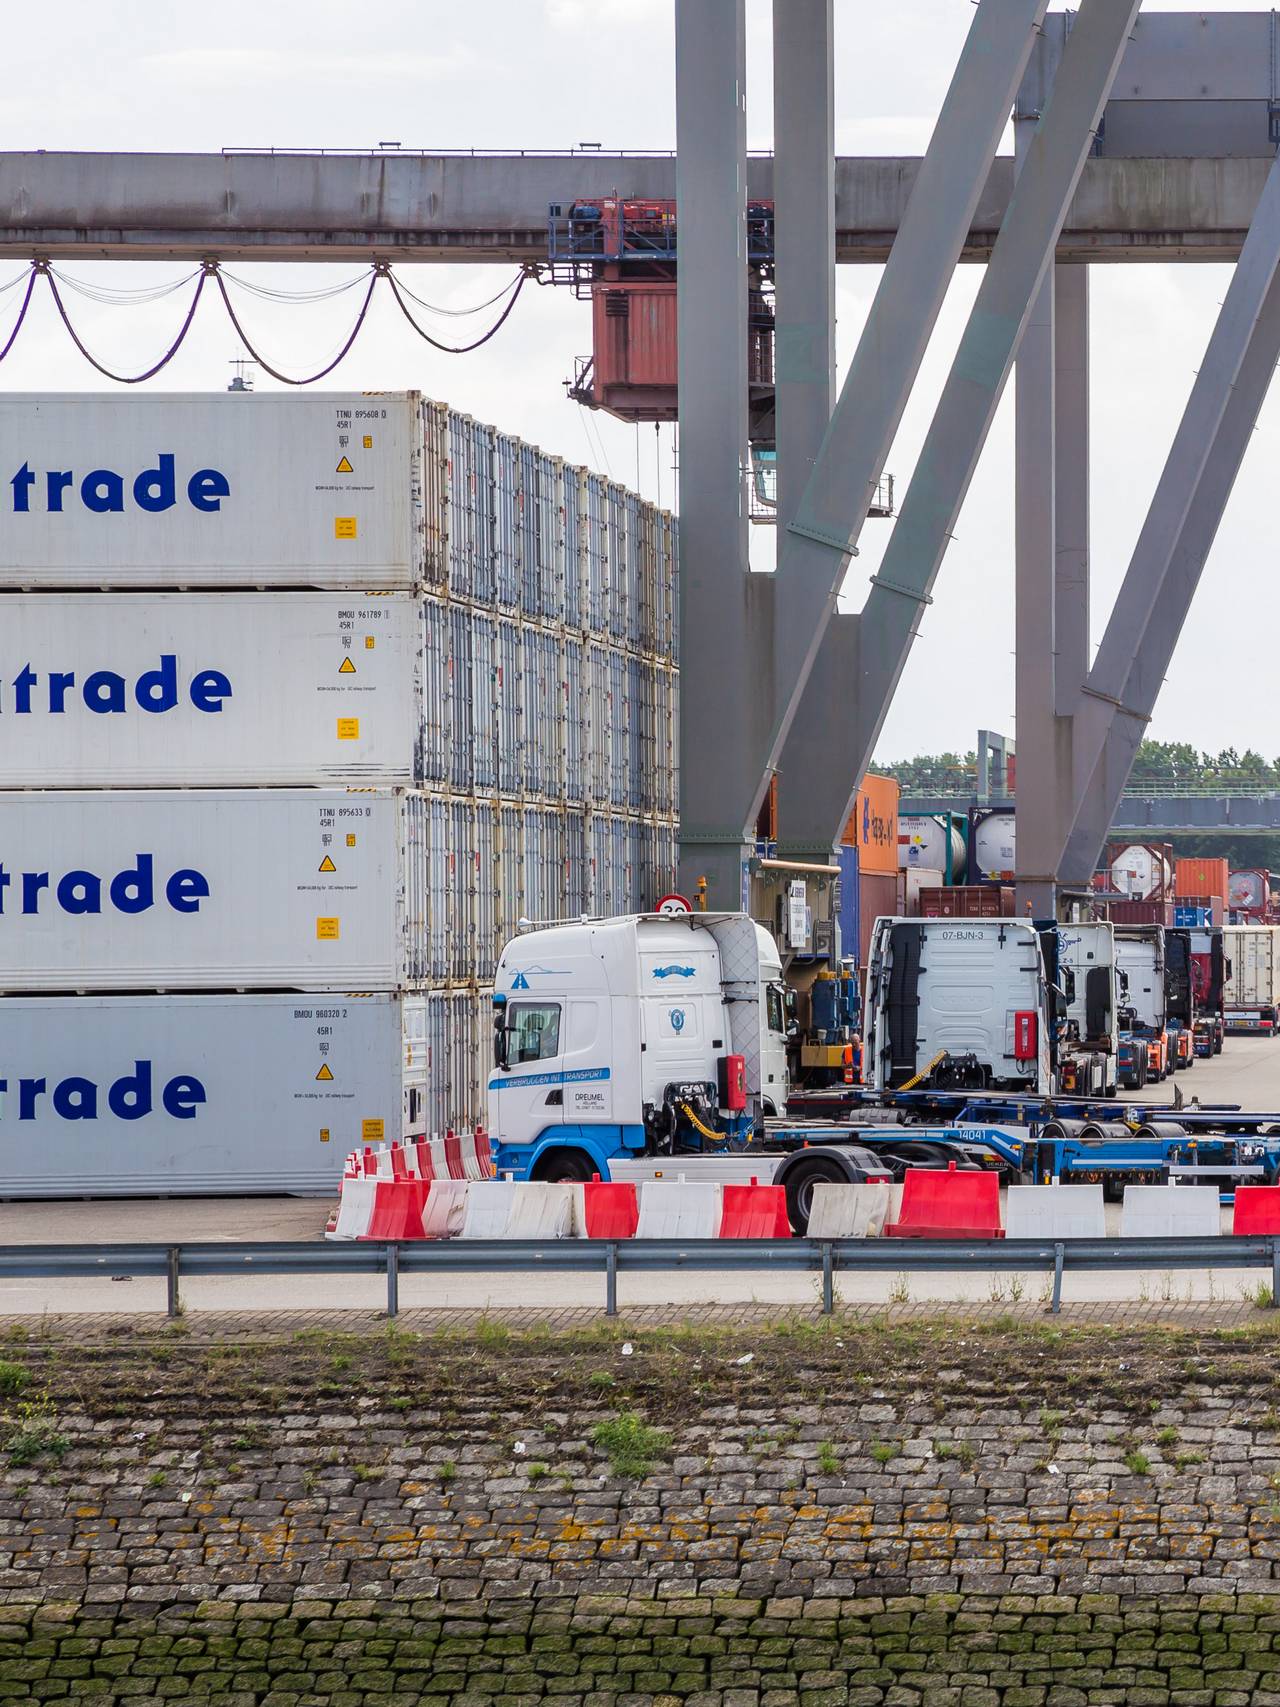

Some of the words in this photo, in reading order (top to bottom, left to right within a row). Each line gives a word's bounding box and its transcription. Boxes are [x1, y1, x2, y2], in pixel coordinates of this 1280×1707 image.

[336, 410, 352, 419] TTNU
[355, 410, 379, 418] 895608
[336, 421, 352, 429] 45R1
[10, 453, 231, 513] trade
[338, 611, 355, 619] BMOU
[358, 611, 382, 619] 961789
[339, 621, 354, 629] 45R1
[0, 654, 233, 714] trade
[319, 809, 335, 817] TTNU
[338, 808, 363, 817] 895633
[319, 819, 335, 827] 45R1
[942, 931, 984, 941] 07-BJN-3
[294, 1009, 313, 1019] BMOU
[315, 1009, 340, 1018] 960320
[342, 1008, 348, 1018] 2
[316, 1026, 333, 1036] 45R1
[505, 1076, 549, 1088] VERBRUGGEN
[563, 1069, 603, 1081] TRANSPORT
[0, 1060, 207, 1121] rade
[575, 1093, 605, 1101] DREUMEL
[958, 1130, 986, 1140] 14041
